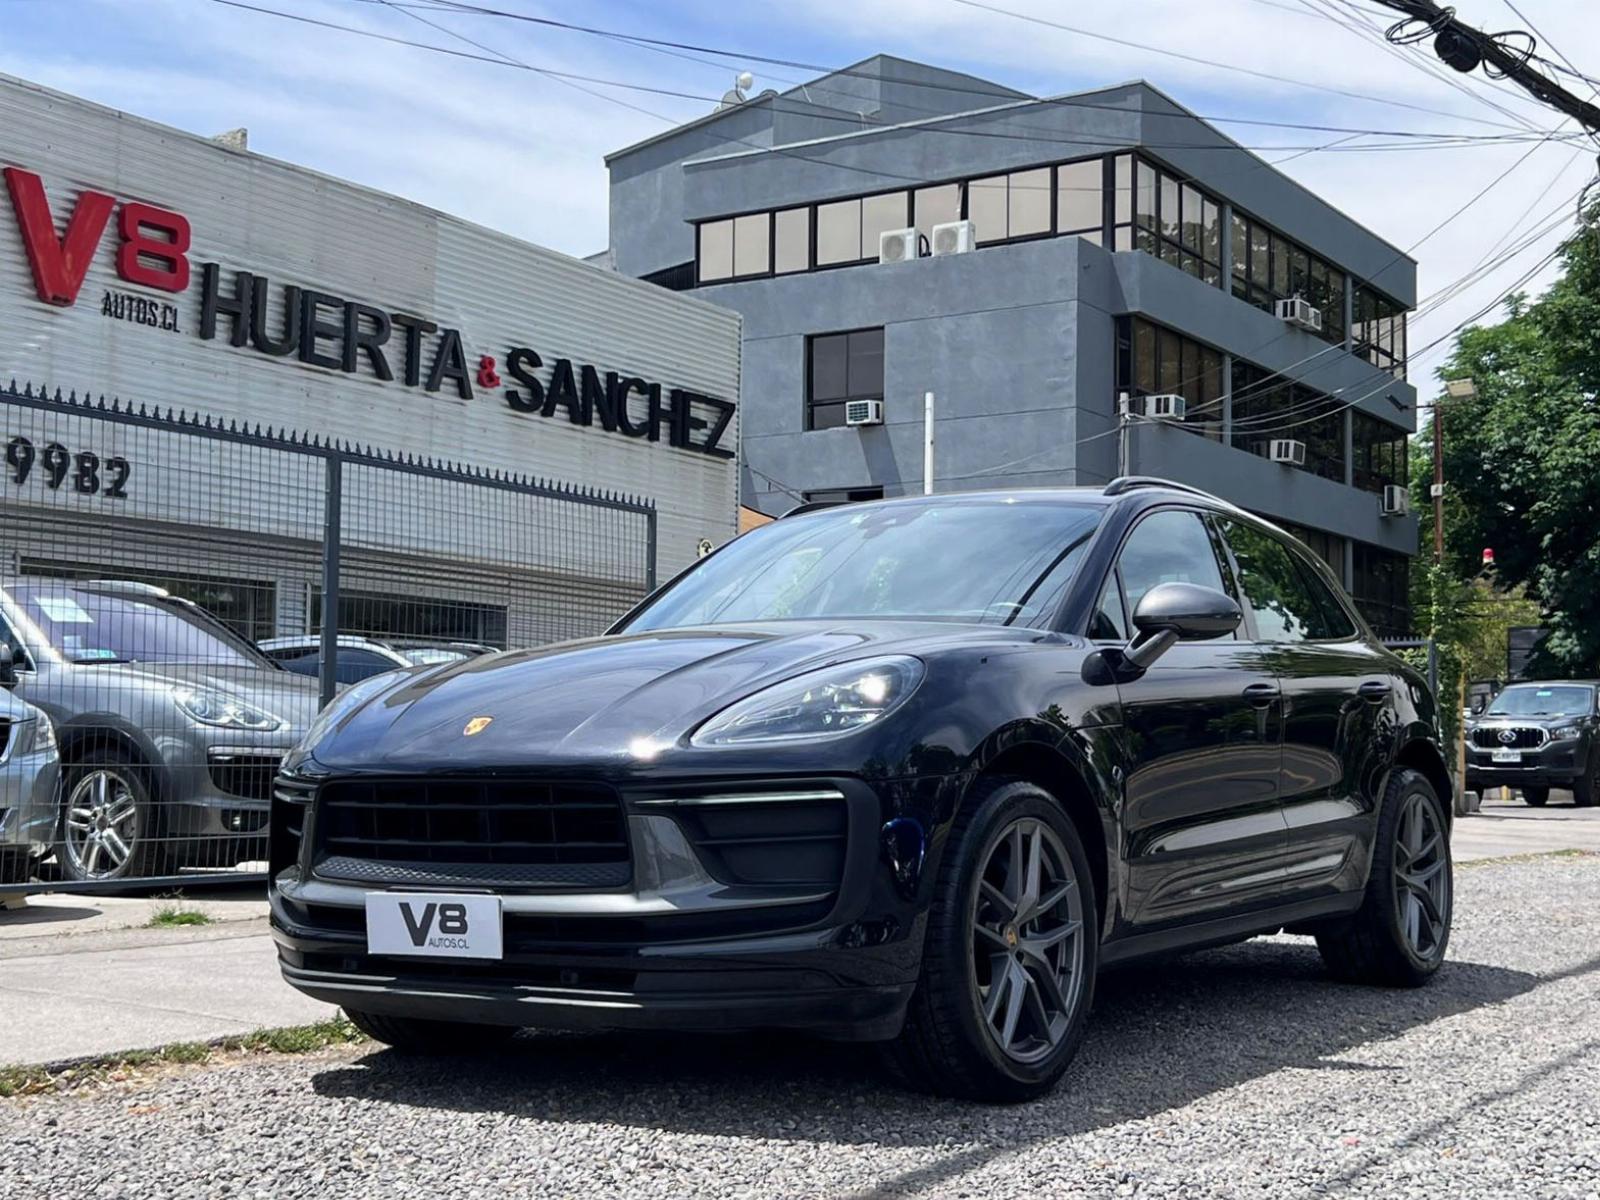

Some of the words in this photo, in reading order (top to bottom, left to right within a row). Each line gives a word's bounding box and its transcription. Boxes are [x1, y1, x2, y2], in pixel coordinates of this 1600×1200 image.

[4, 167, 191, 307] V8
[102, 291, 180, 333] AUTOS.CL
[200, 262, 473, 400] HUERTA
[477, 356, 500, 388] &
[506, 348, 736, 458] SANCHEZ
[7, 436, 130, 498] 9982
[398, 902, 468, 947] V8
[428, 937, 470, 949] AUTOS.CL
